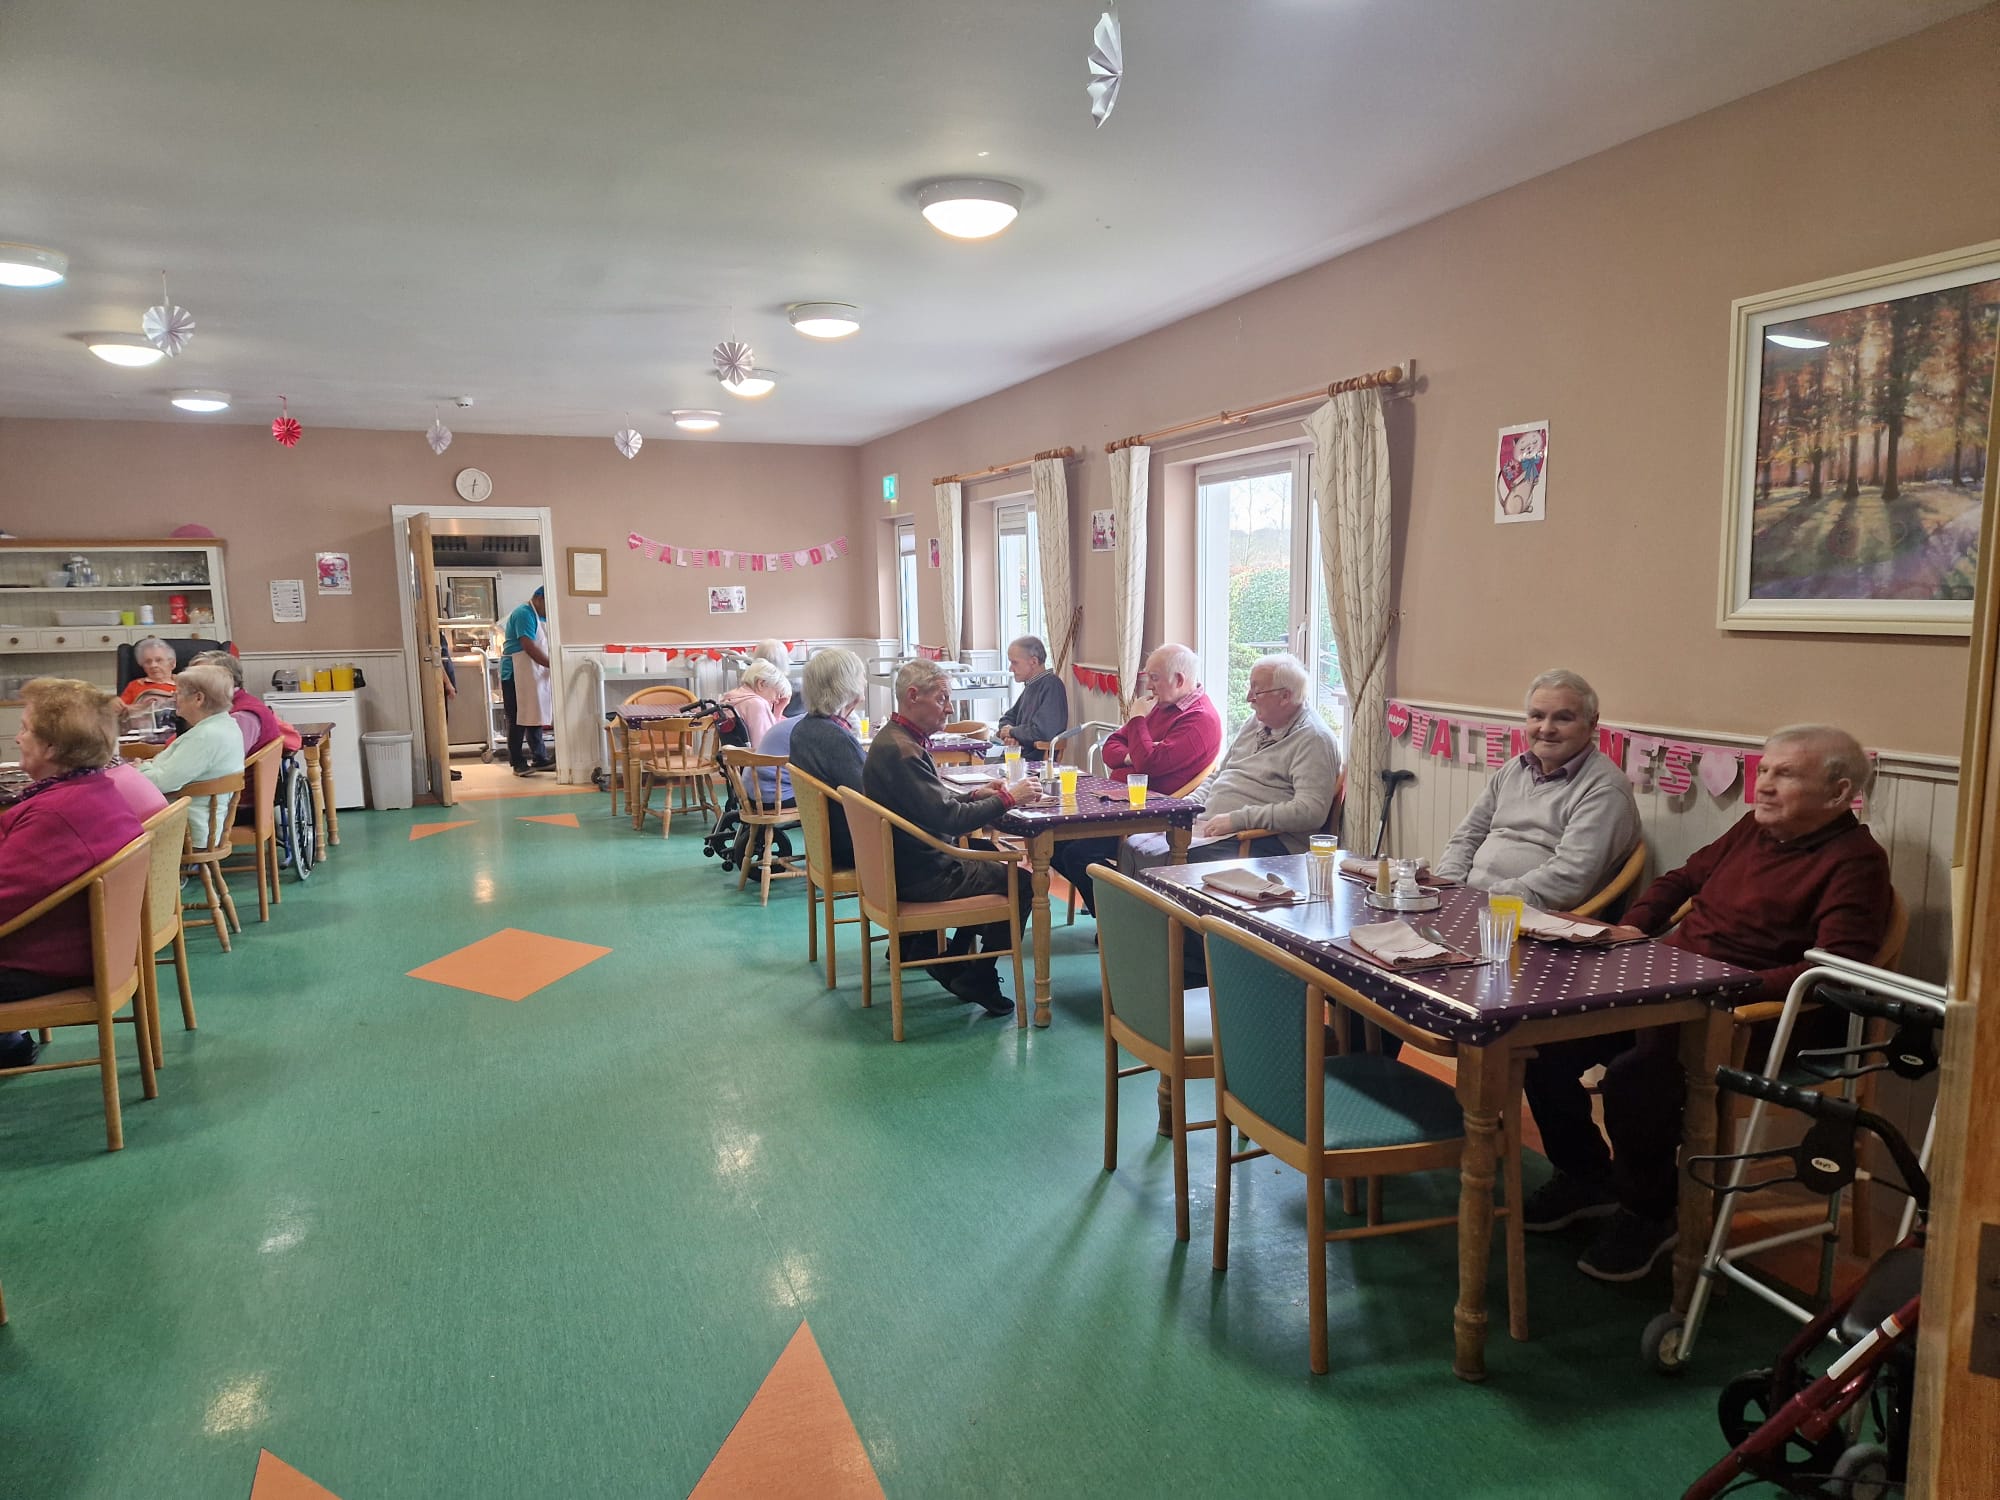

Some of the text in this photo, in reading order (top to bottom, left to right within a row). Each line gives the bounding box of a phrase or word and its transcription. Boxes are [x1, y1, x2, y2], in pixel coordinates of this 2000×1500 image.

[809, 536, 848, 565] DAY
[1388, 715, 1407, 727] HAPPY
[1411, 709, 1692, 796] VALENNES
